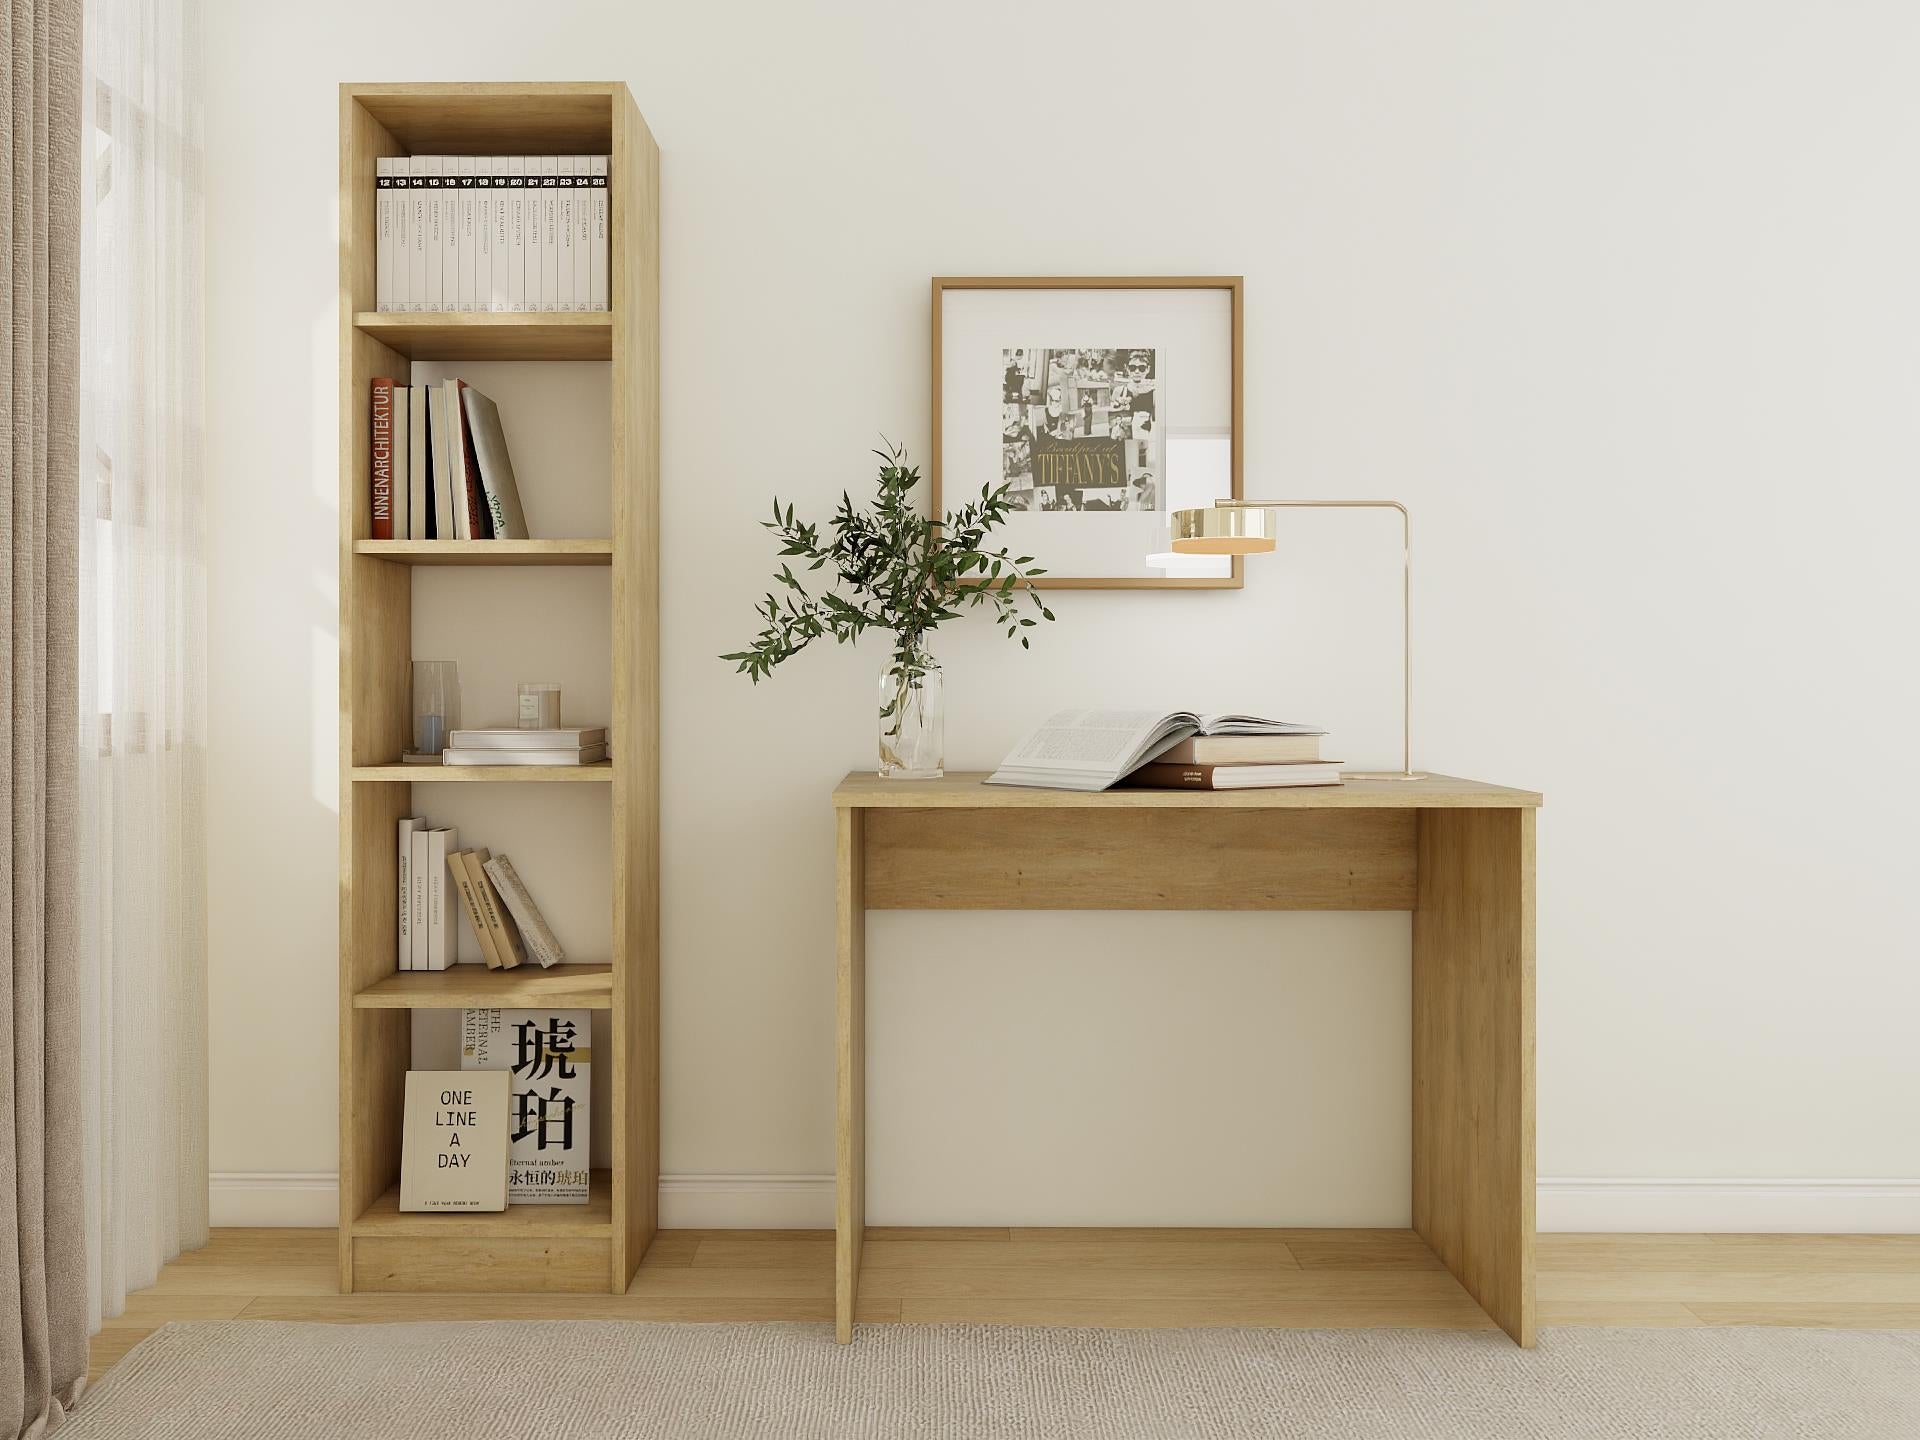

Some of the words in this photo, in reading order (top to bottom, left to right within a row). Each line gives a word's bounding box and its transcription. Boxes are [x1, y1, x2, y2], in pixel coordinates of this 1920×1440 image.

[378, 179, 390, 187] 12
[395, 179, 407, 187] 13
[461, 179, 472, 187] 17
[373, 386, 389, 520] INNENARCHITEKTUR
[1037, 453, 1119, 484] TIFFANY'S
[491, 1008, 501, 1033] THE
[466, 1008, 476, 1051] AMBER
[478, 1008, 489, 1065] ETERNAL
[511, 1017, 577, 1151] 琥珀
[440, 1090, 473, 1106] ONE
[435, 1111, 477, 1126] LINE
[449, 1133, 461, 1147] A
[438, 1153, 472, 1168] DAY
[509, 1170, 588, 1187] 永恒的琥珀
